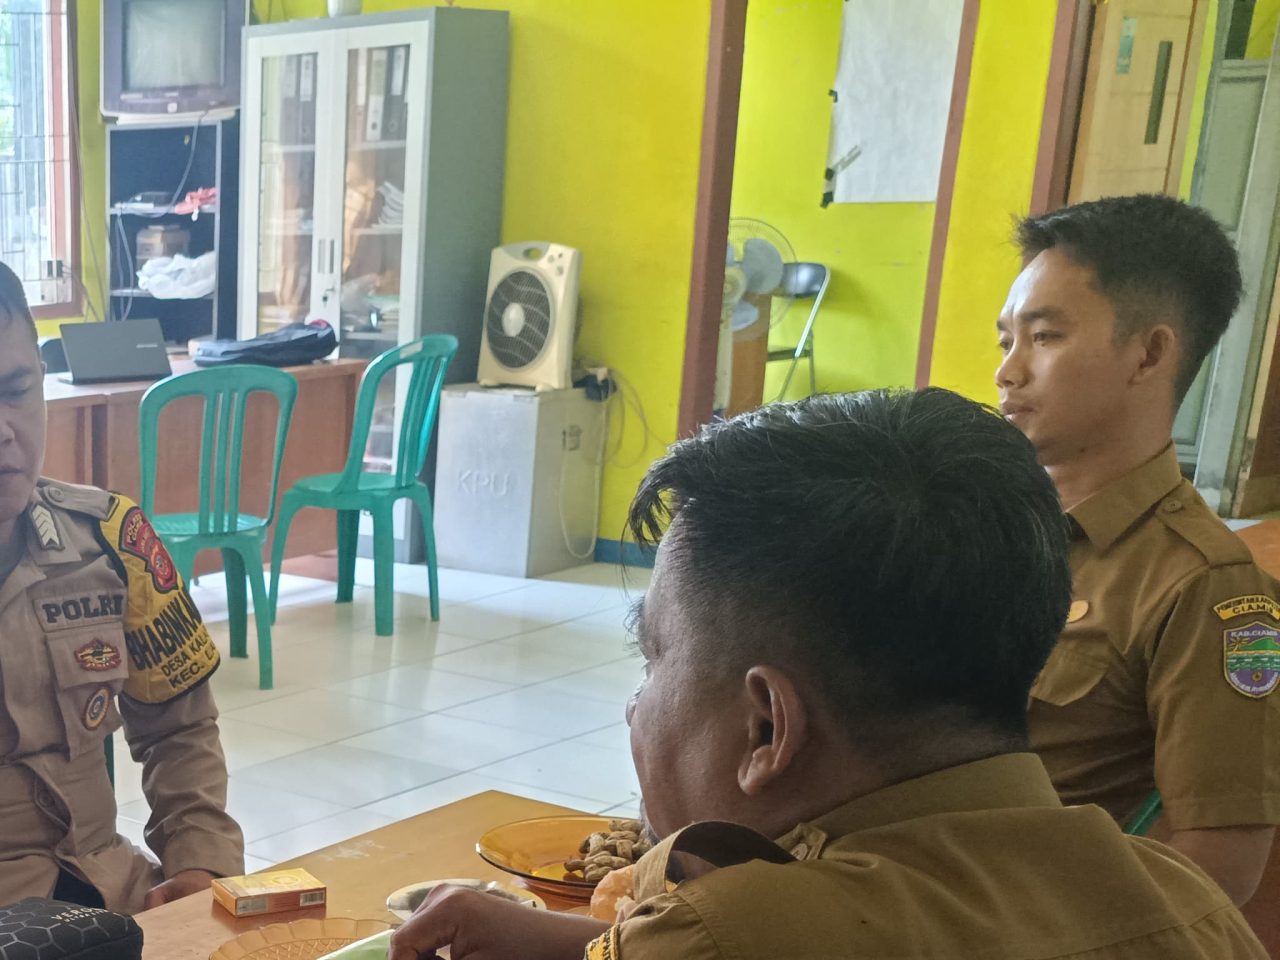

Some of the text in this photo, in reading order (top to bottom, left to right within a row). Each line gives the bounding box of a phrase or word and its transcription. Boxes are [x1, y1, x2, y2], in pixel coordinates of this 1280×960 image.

[456, 468, 510, 498] KPU
[42, 594, 124, 624] POLRI
[160, 651, 190, 676] DESA
[168, 661, 206, 689] KEC.
